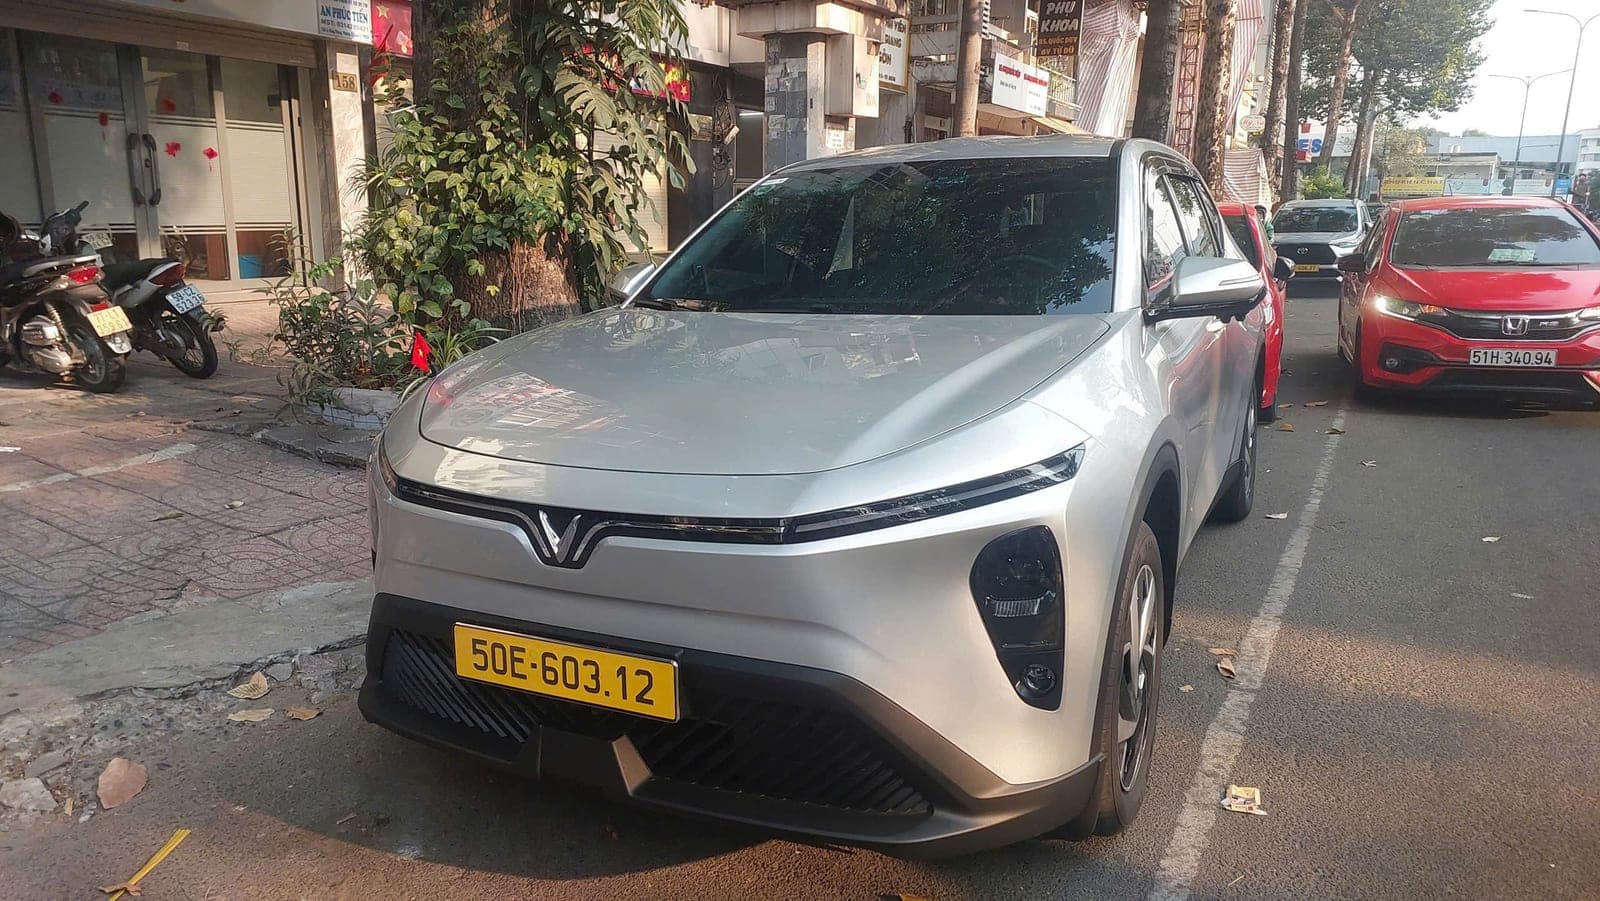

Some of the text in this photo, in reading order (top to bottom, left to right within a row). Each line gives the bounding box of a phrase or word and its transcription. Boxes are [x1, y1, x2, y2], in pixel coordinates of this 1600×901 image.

[320, 5, 368, 24] AN PHÚC TIẾN
[1046, 1, 1076, 17] PHỤ
[1041, 19, 1079, 33] KHOA
[336, 75, 355, 90] 158
[1472, 350, 1552, 366] 51H-340.94
[471, 638, 654, 706] 50E-603.12
